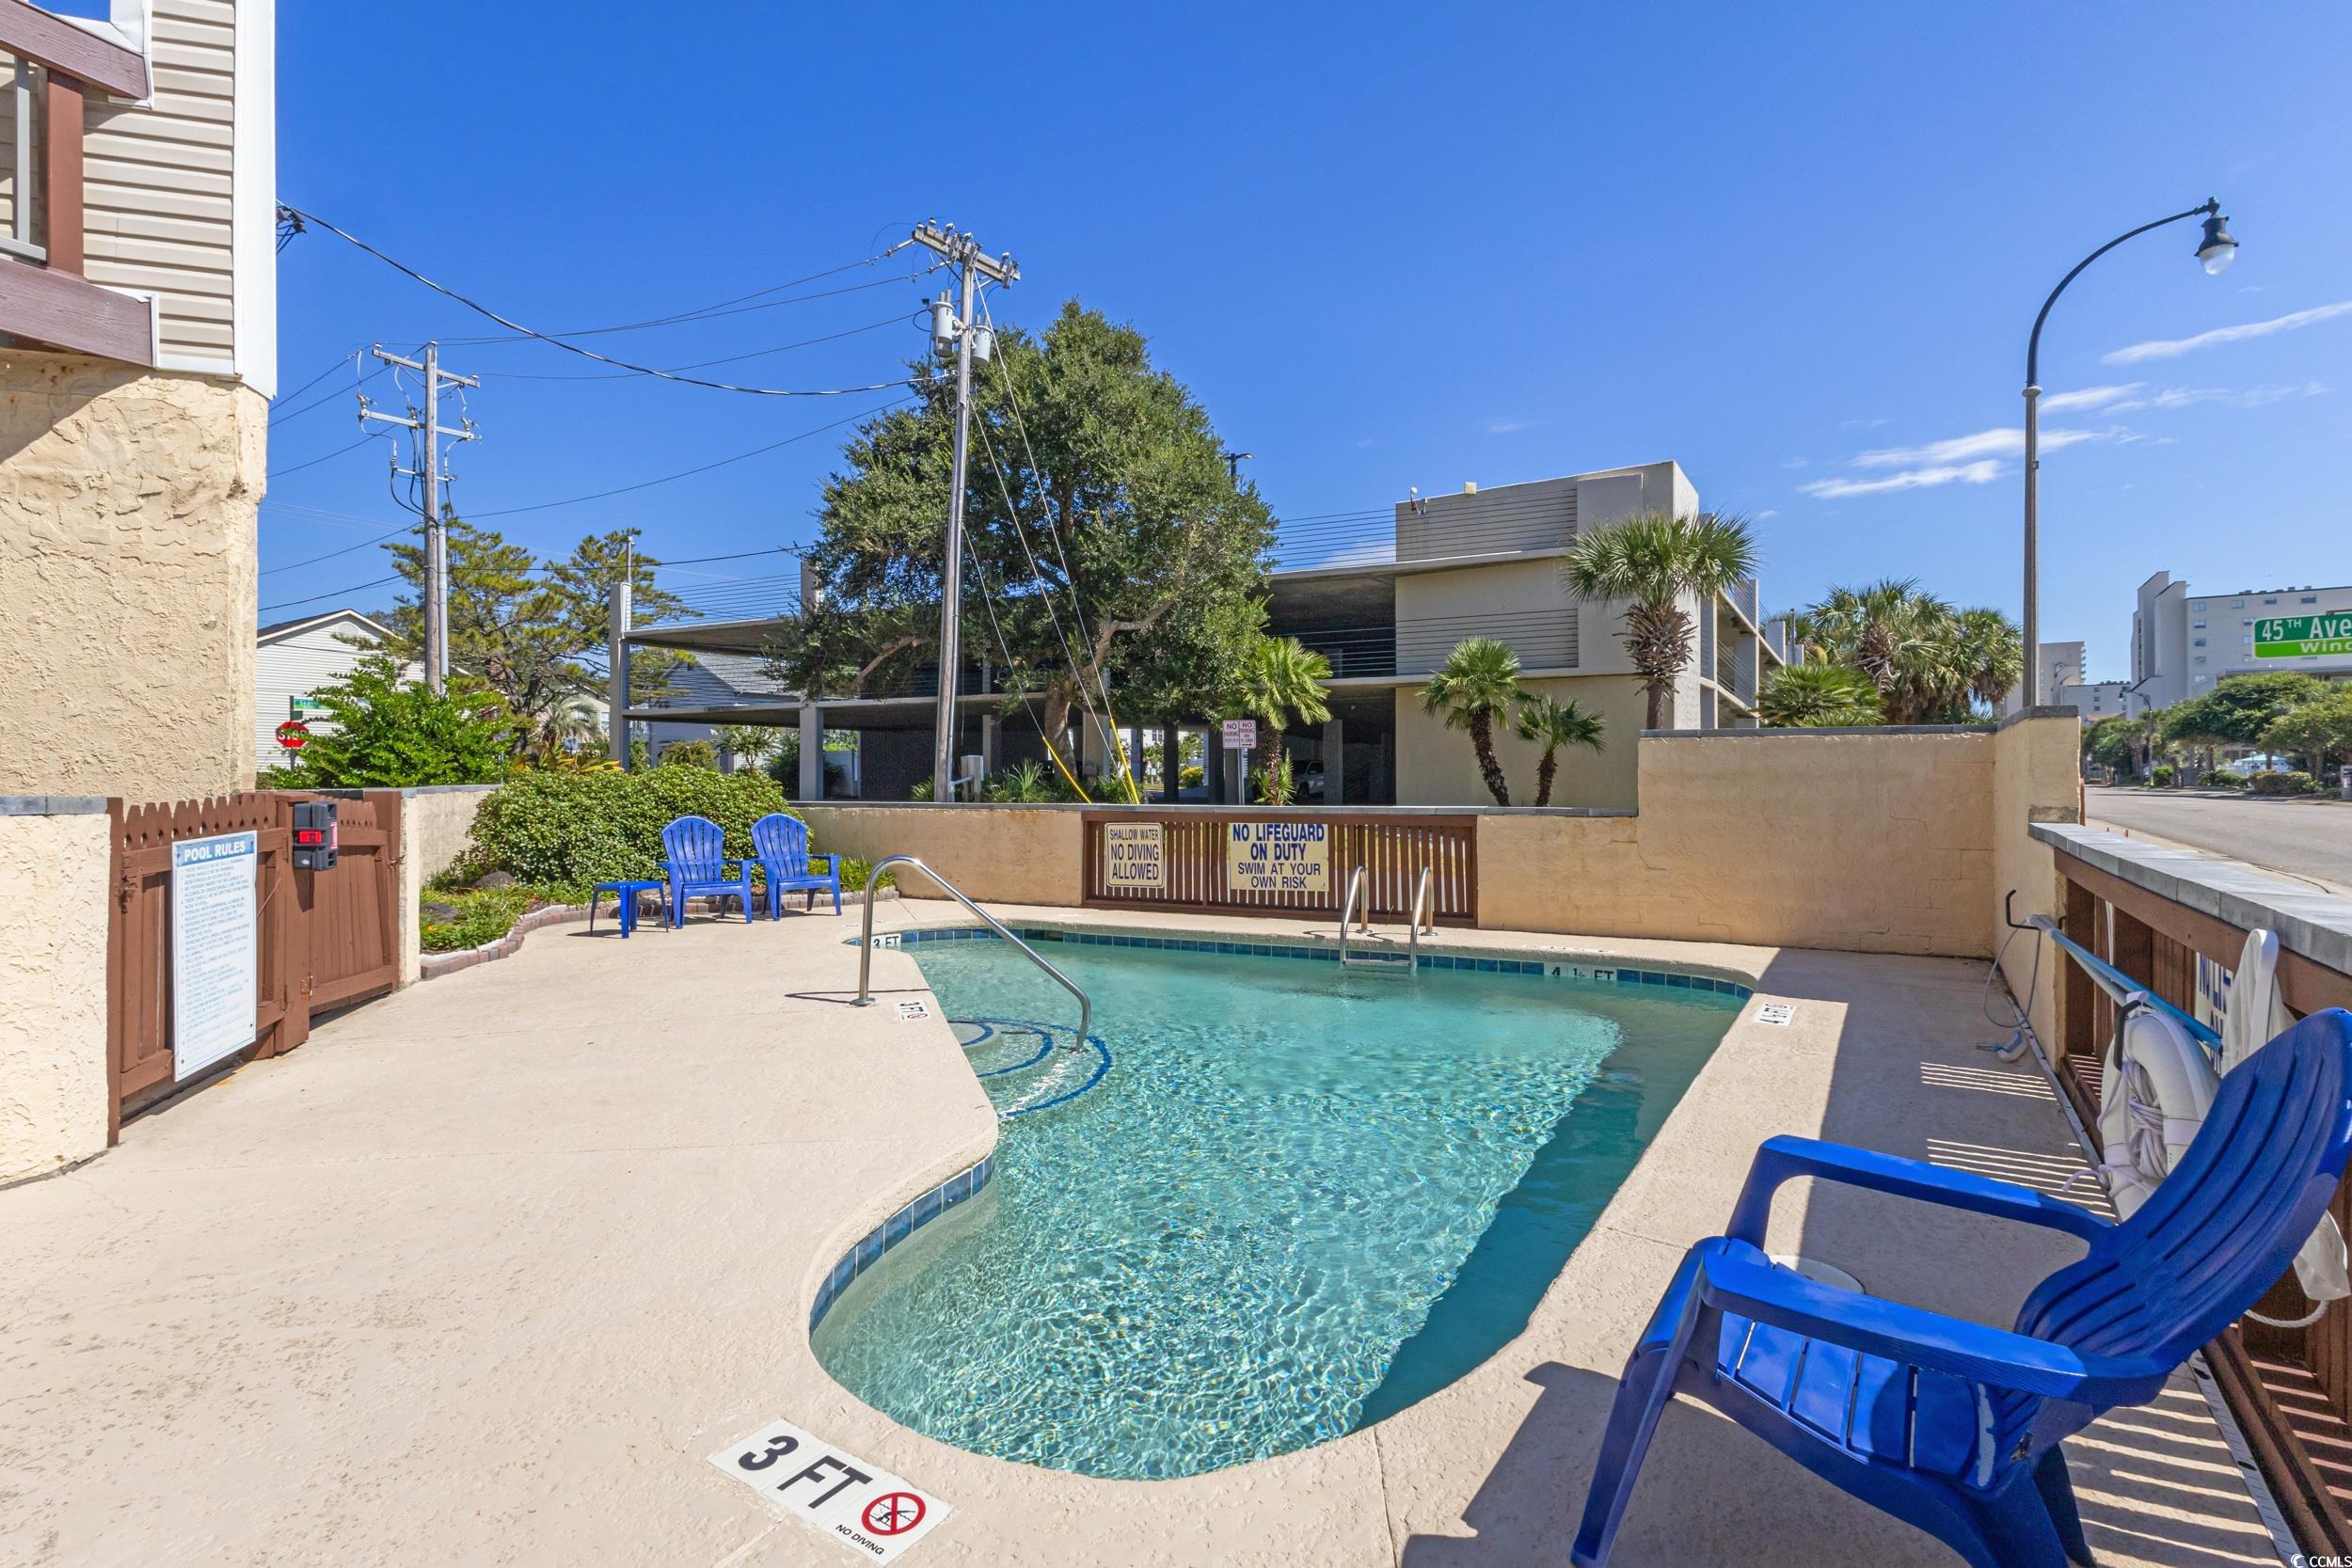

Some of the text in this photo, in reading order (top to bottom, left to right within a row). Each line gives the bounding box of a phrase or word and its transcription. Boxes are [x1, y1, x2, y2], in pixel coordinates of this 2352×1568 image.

[278, 729, 309, 740] SOP
[1110, 829, 1158, 840] SHALLOW WATER
[1232, 823, 1325, 841] NO LIFEGUARD
[184, 840, 246, 863] POOL RULES
[1111, 844, 1159, 861] NO DIVING
[1250, 843, 1306, 861] ON DUTY
[1112, 863, 1159, 880] ALLOWED
[1238, 863, 1321, 876] SWIM AT YOUR
[1251, 876, 1307, 889] OWN RISK
[738, 1435, 873, 1510] 3 FT
[835, 1524, 884, 1555] NO DIVING
